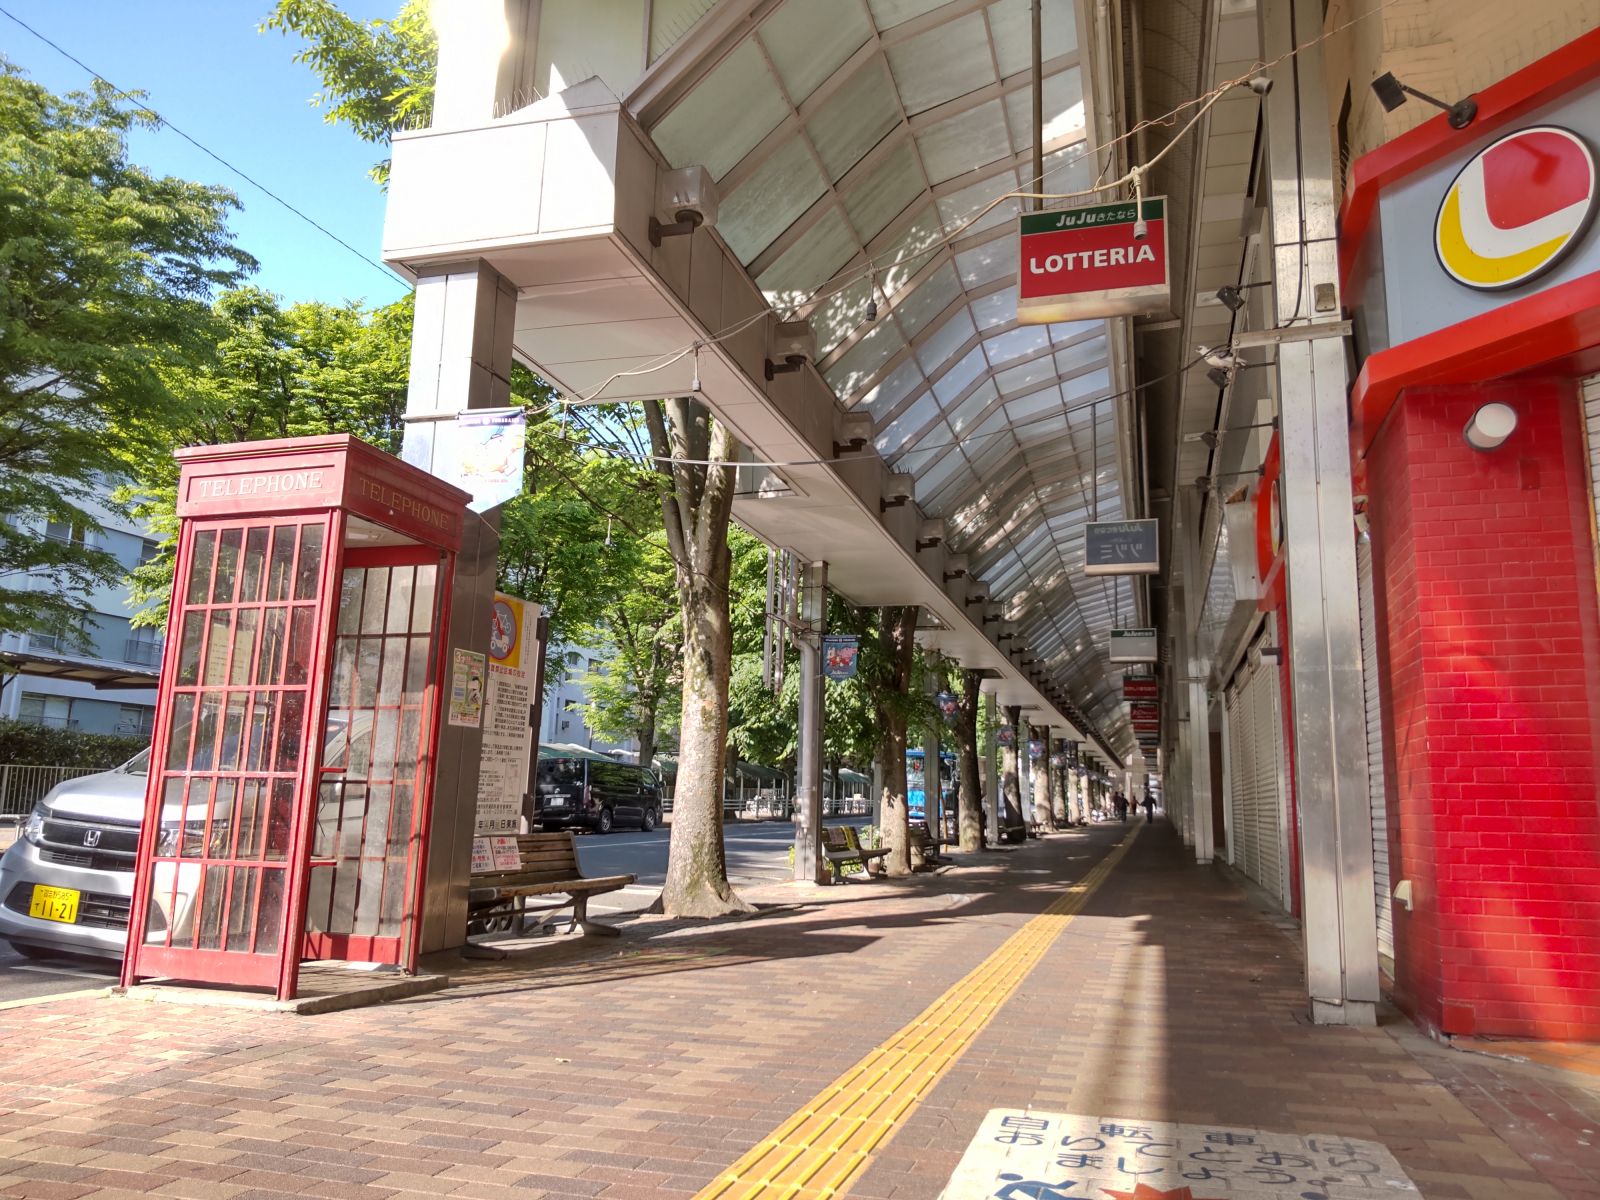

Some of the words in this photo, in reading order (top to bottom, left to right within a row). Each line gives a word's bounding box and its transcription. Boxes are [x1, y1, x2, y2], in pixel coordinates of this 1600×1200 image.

[1055, 208, 1137, 228] JuJuきたなら
[1029, 244, 1156, 275] LOTTERIA
[200, 472, 323, 498] TELEPHONE
[360, 477, 449, 531] TELEPHONE
[1000, 1115, 1371, 1158] 自転車は
